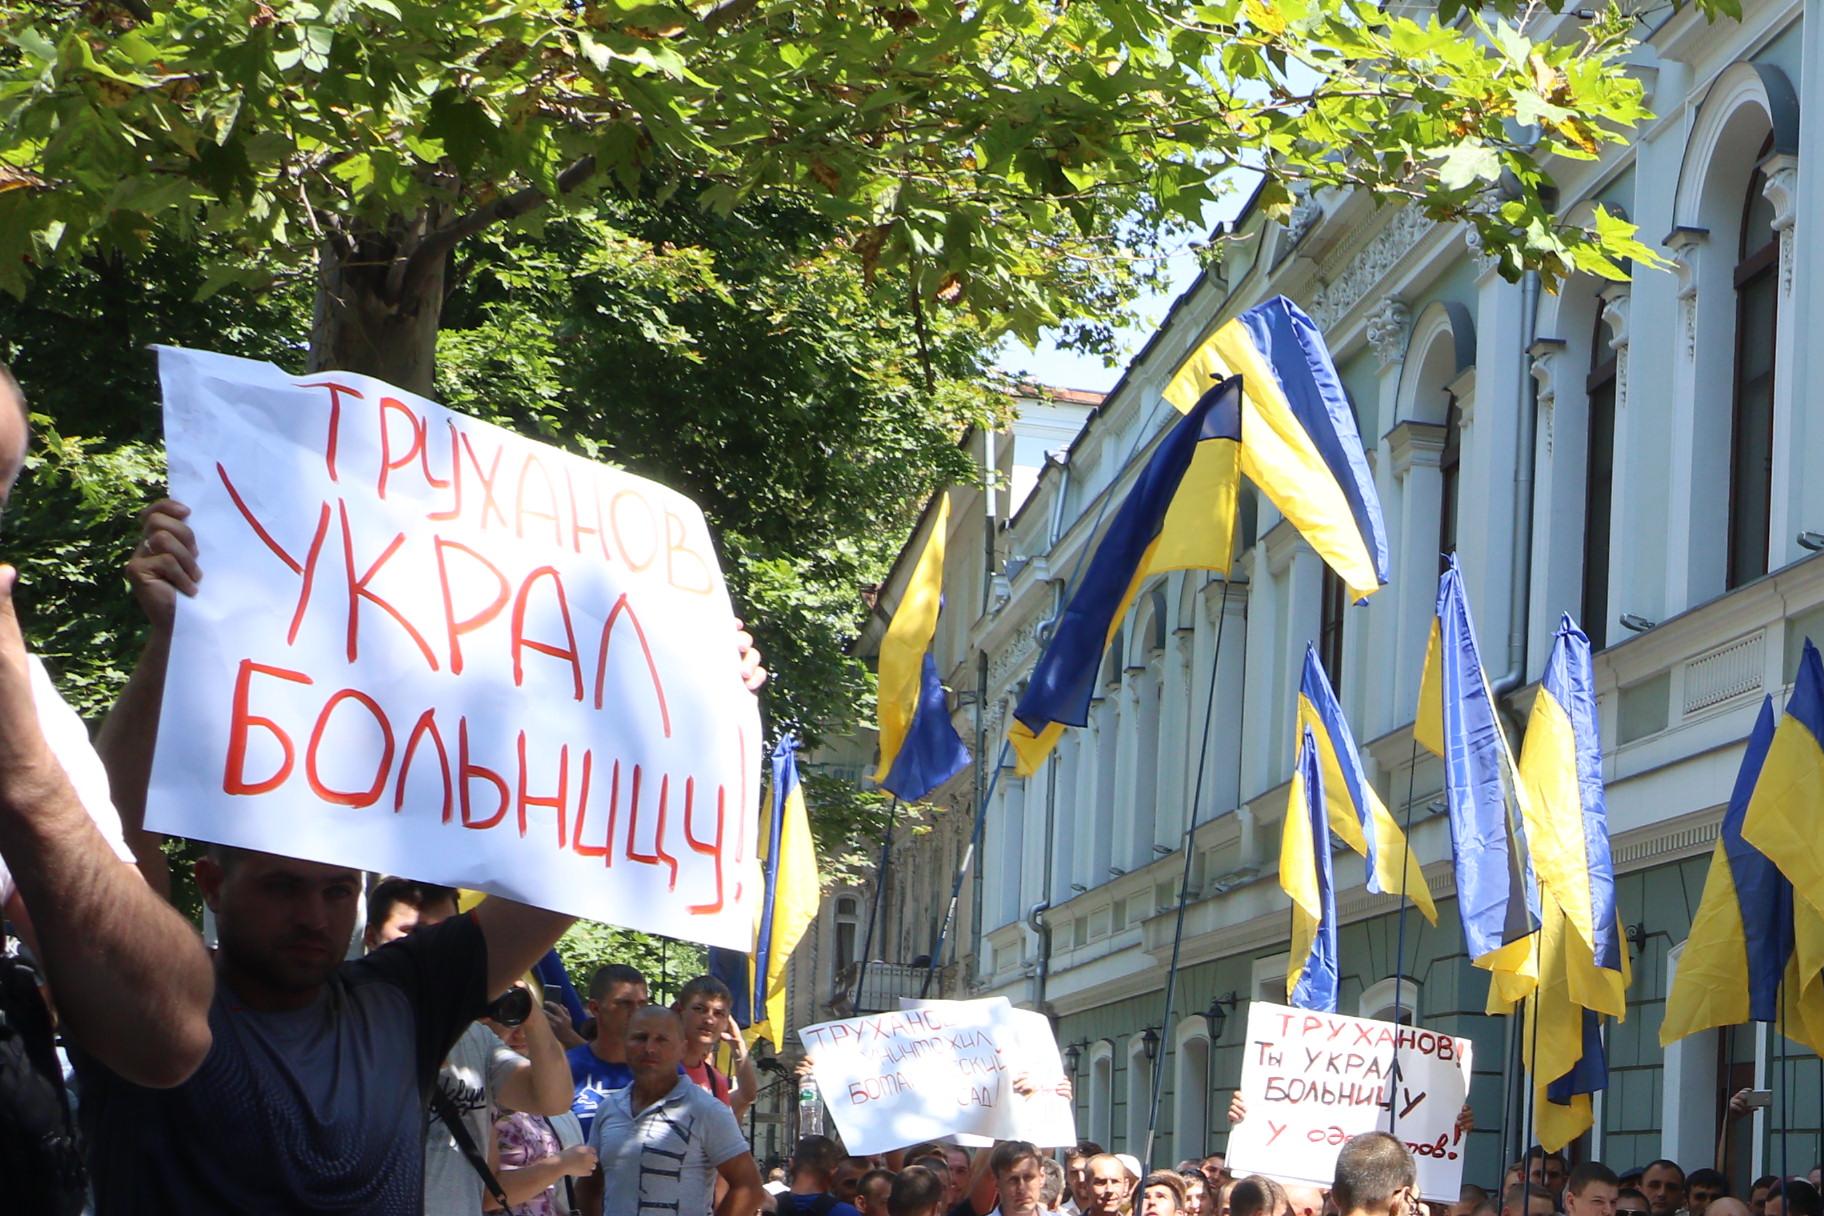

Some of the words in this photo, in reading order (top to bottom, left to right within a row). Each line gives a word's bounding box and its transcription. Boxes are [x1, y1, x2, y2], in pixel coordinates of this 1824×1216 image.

[290, 382, 714, 595] ТРУХАНОВ
[215, 460, 670, 738] УКРАЛ
[805, 1009, 956, 1049] ТРУХАНО
[1276, 1013, 1464, 1068] ТРУХАНОВ!
[1303, 1046, 1404, 1083] УКРАЛ
[1264, 1076, 1427, 1120] БОЛЬНИЦУ
